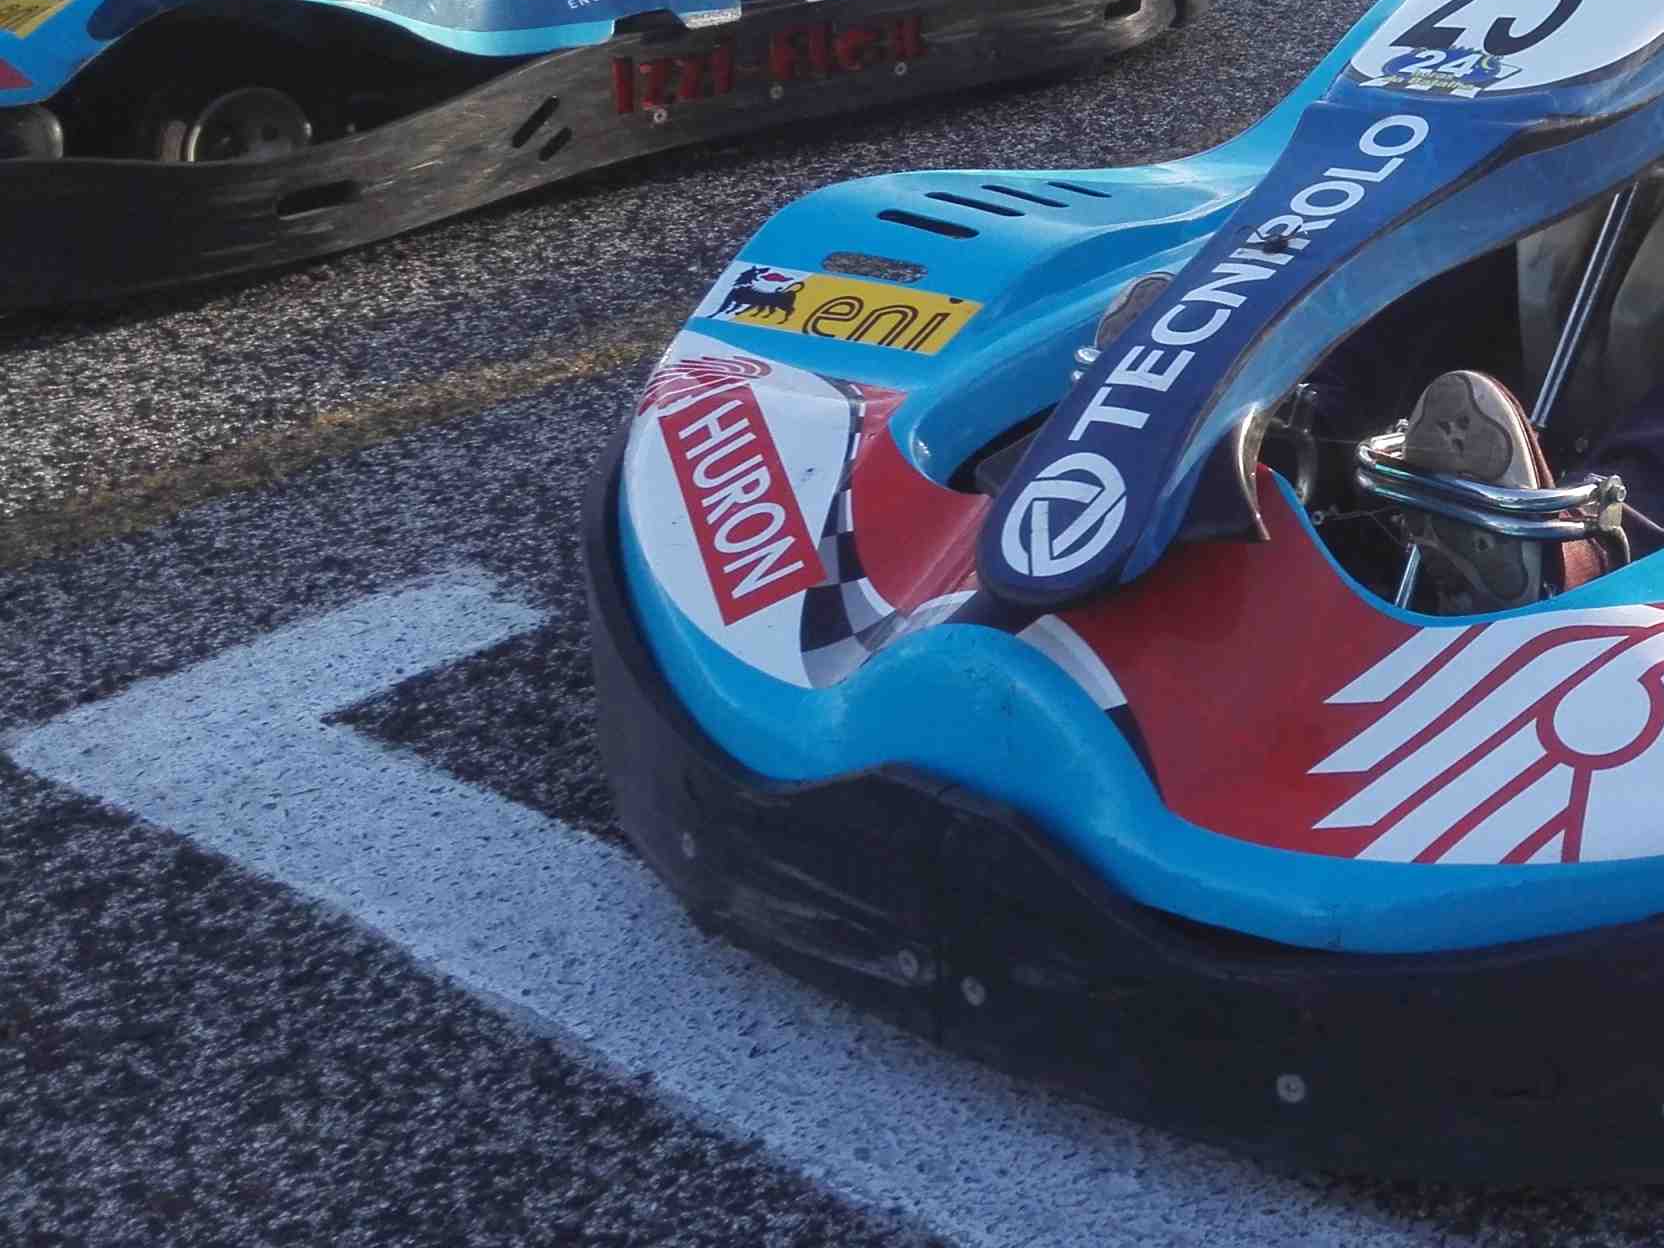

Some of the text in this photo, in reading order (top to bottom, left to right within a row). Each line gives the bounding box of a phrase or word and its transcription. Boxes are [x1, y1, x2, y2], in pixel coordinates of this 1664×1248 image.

[1399, 49, 1484, 78] 24
[802, 295, 964, 353] eni
[1072, 114, 1430, 442] TECNIROLO
[678, 405, 805, 601] HURON
